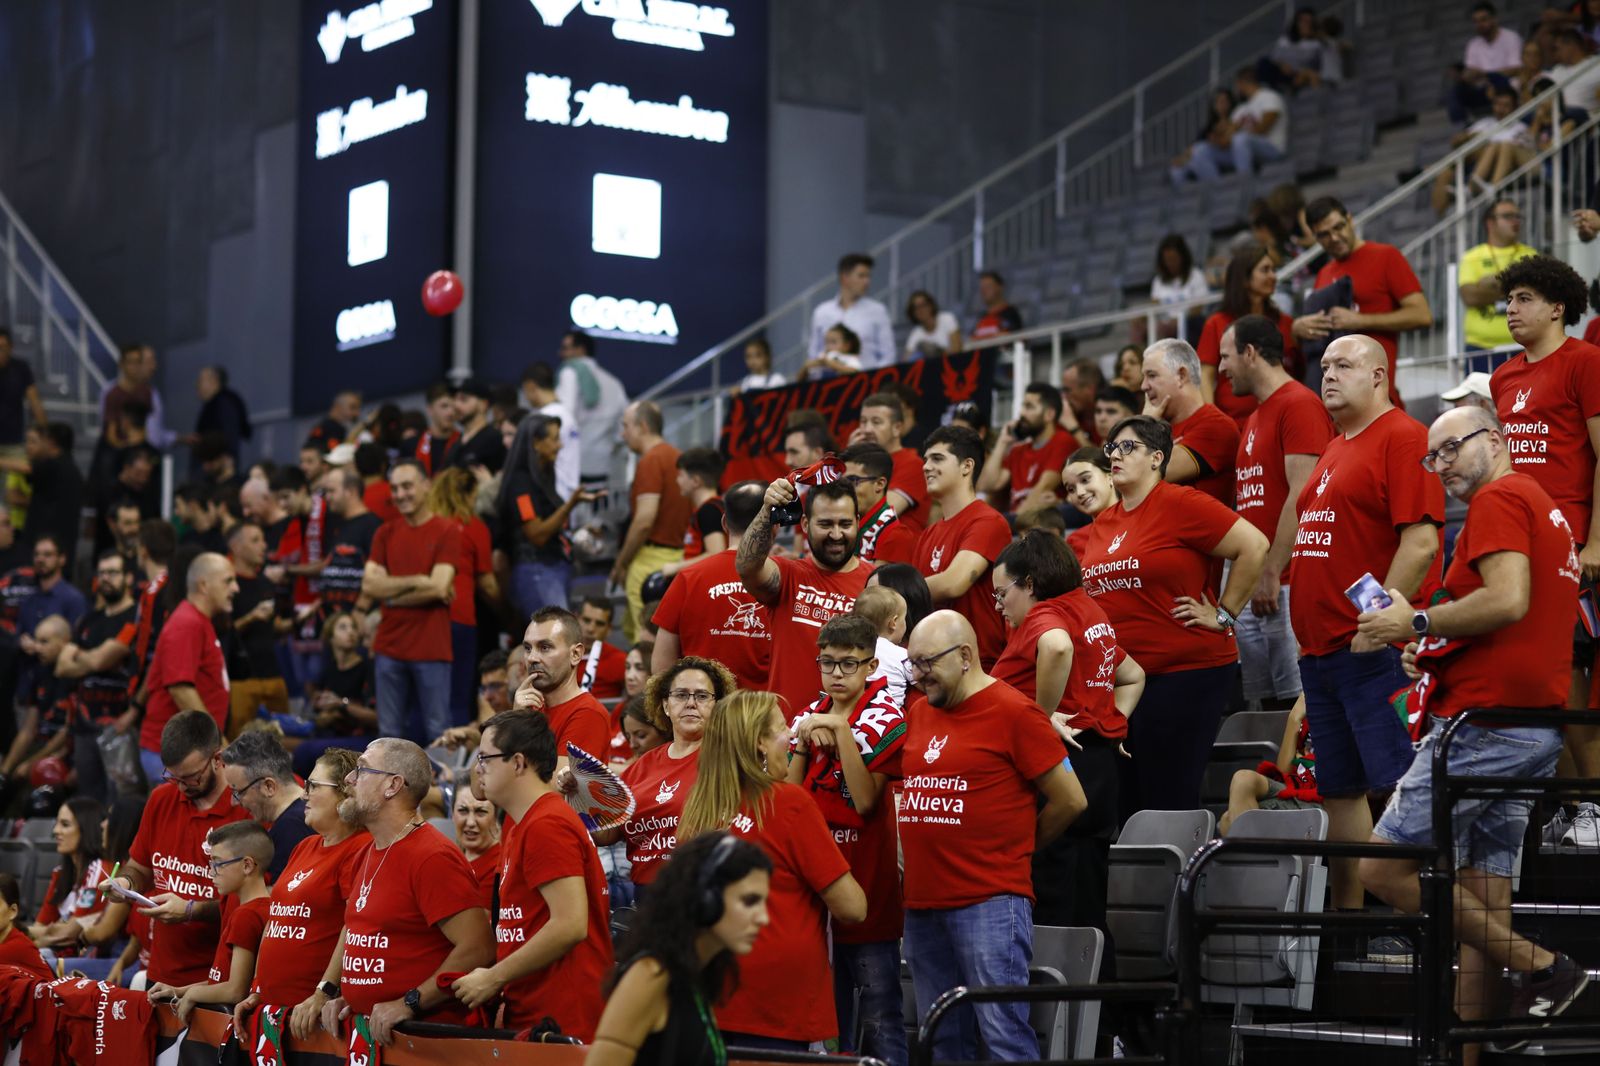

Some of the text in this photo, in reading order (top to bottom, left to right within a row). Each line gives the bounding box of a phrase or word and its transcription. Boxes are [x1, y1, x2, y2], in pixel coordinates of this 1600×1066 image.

[1514, 457, 1547, 465] GRANADA
[1302, 550, 1329, 558] GRANADA
[1097, 577, 1142, 594] Nueva
[793, 601, 810, 616] CB
[905, 791, 964, 814] Nueva
[923, 816, 962, 825] GRANADA
[167, 873, 214, 899] Nueva
[266, 920, 307, 940] Nueva
